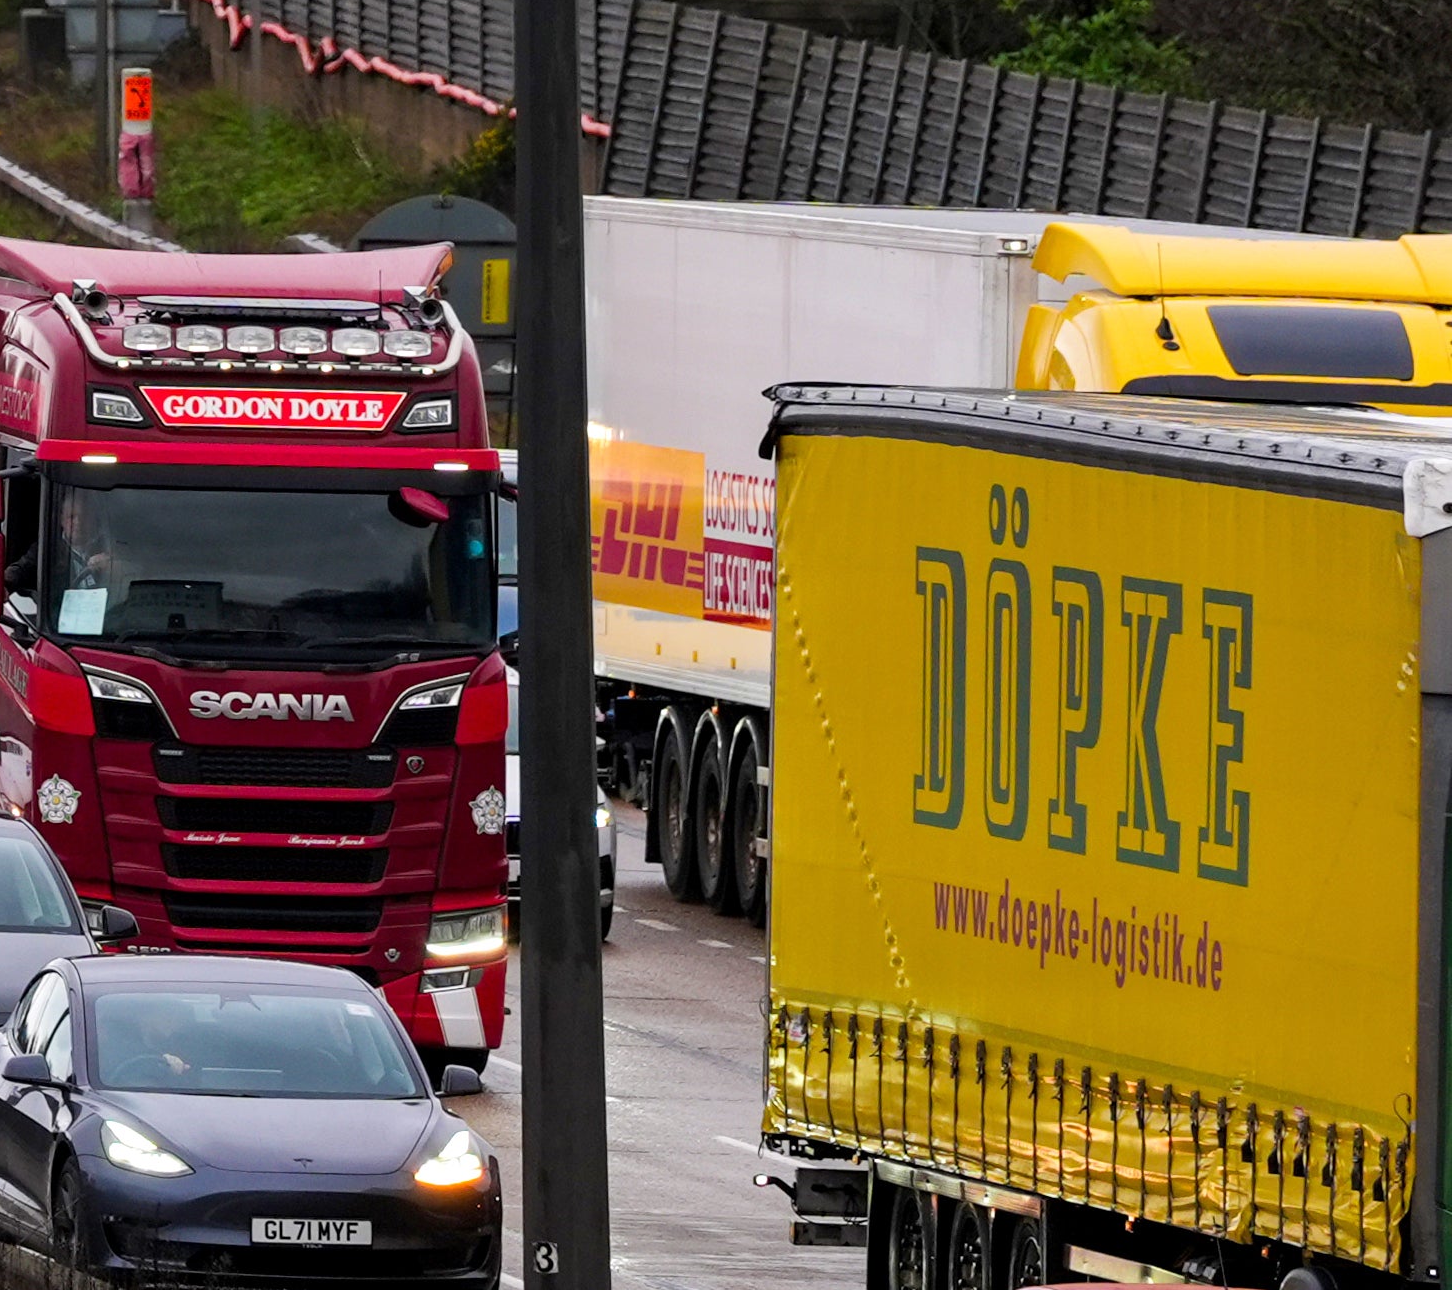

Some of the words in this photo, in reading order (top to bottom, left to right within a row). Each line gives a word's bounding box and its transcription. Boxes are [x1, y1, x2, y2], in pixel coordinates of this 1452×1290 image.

[162, 394, 283, 420] GORDON
[288, 396, 385, 422] DOYLE
[705, 469, 759, 536] LOGISTICS
[599, 478, 688, 587] DHL
[705, 552, 724, 611] LIFE
[725, 554, 773, 621] SCIENCES
[188, 690, 355, 722] SCANIA
[912, 483, 1254, 888] DÖPKE
[287, 834, 337, 847] Benjamin
[933, 877, 1223, 992] www.doepke-logistik.de
[264, 1220, 312, 1241] GL71
[318, 1221, 359, 1242] MYF
[535, 1242, 554, 1273] 3
